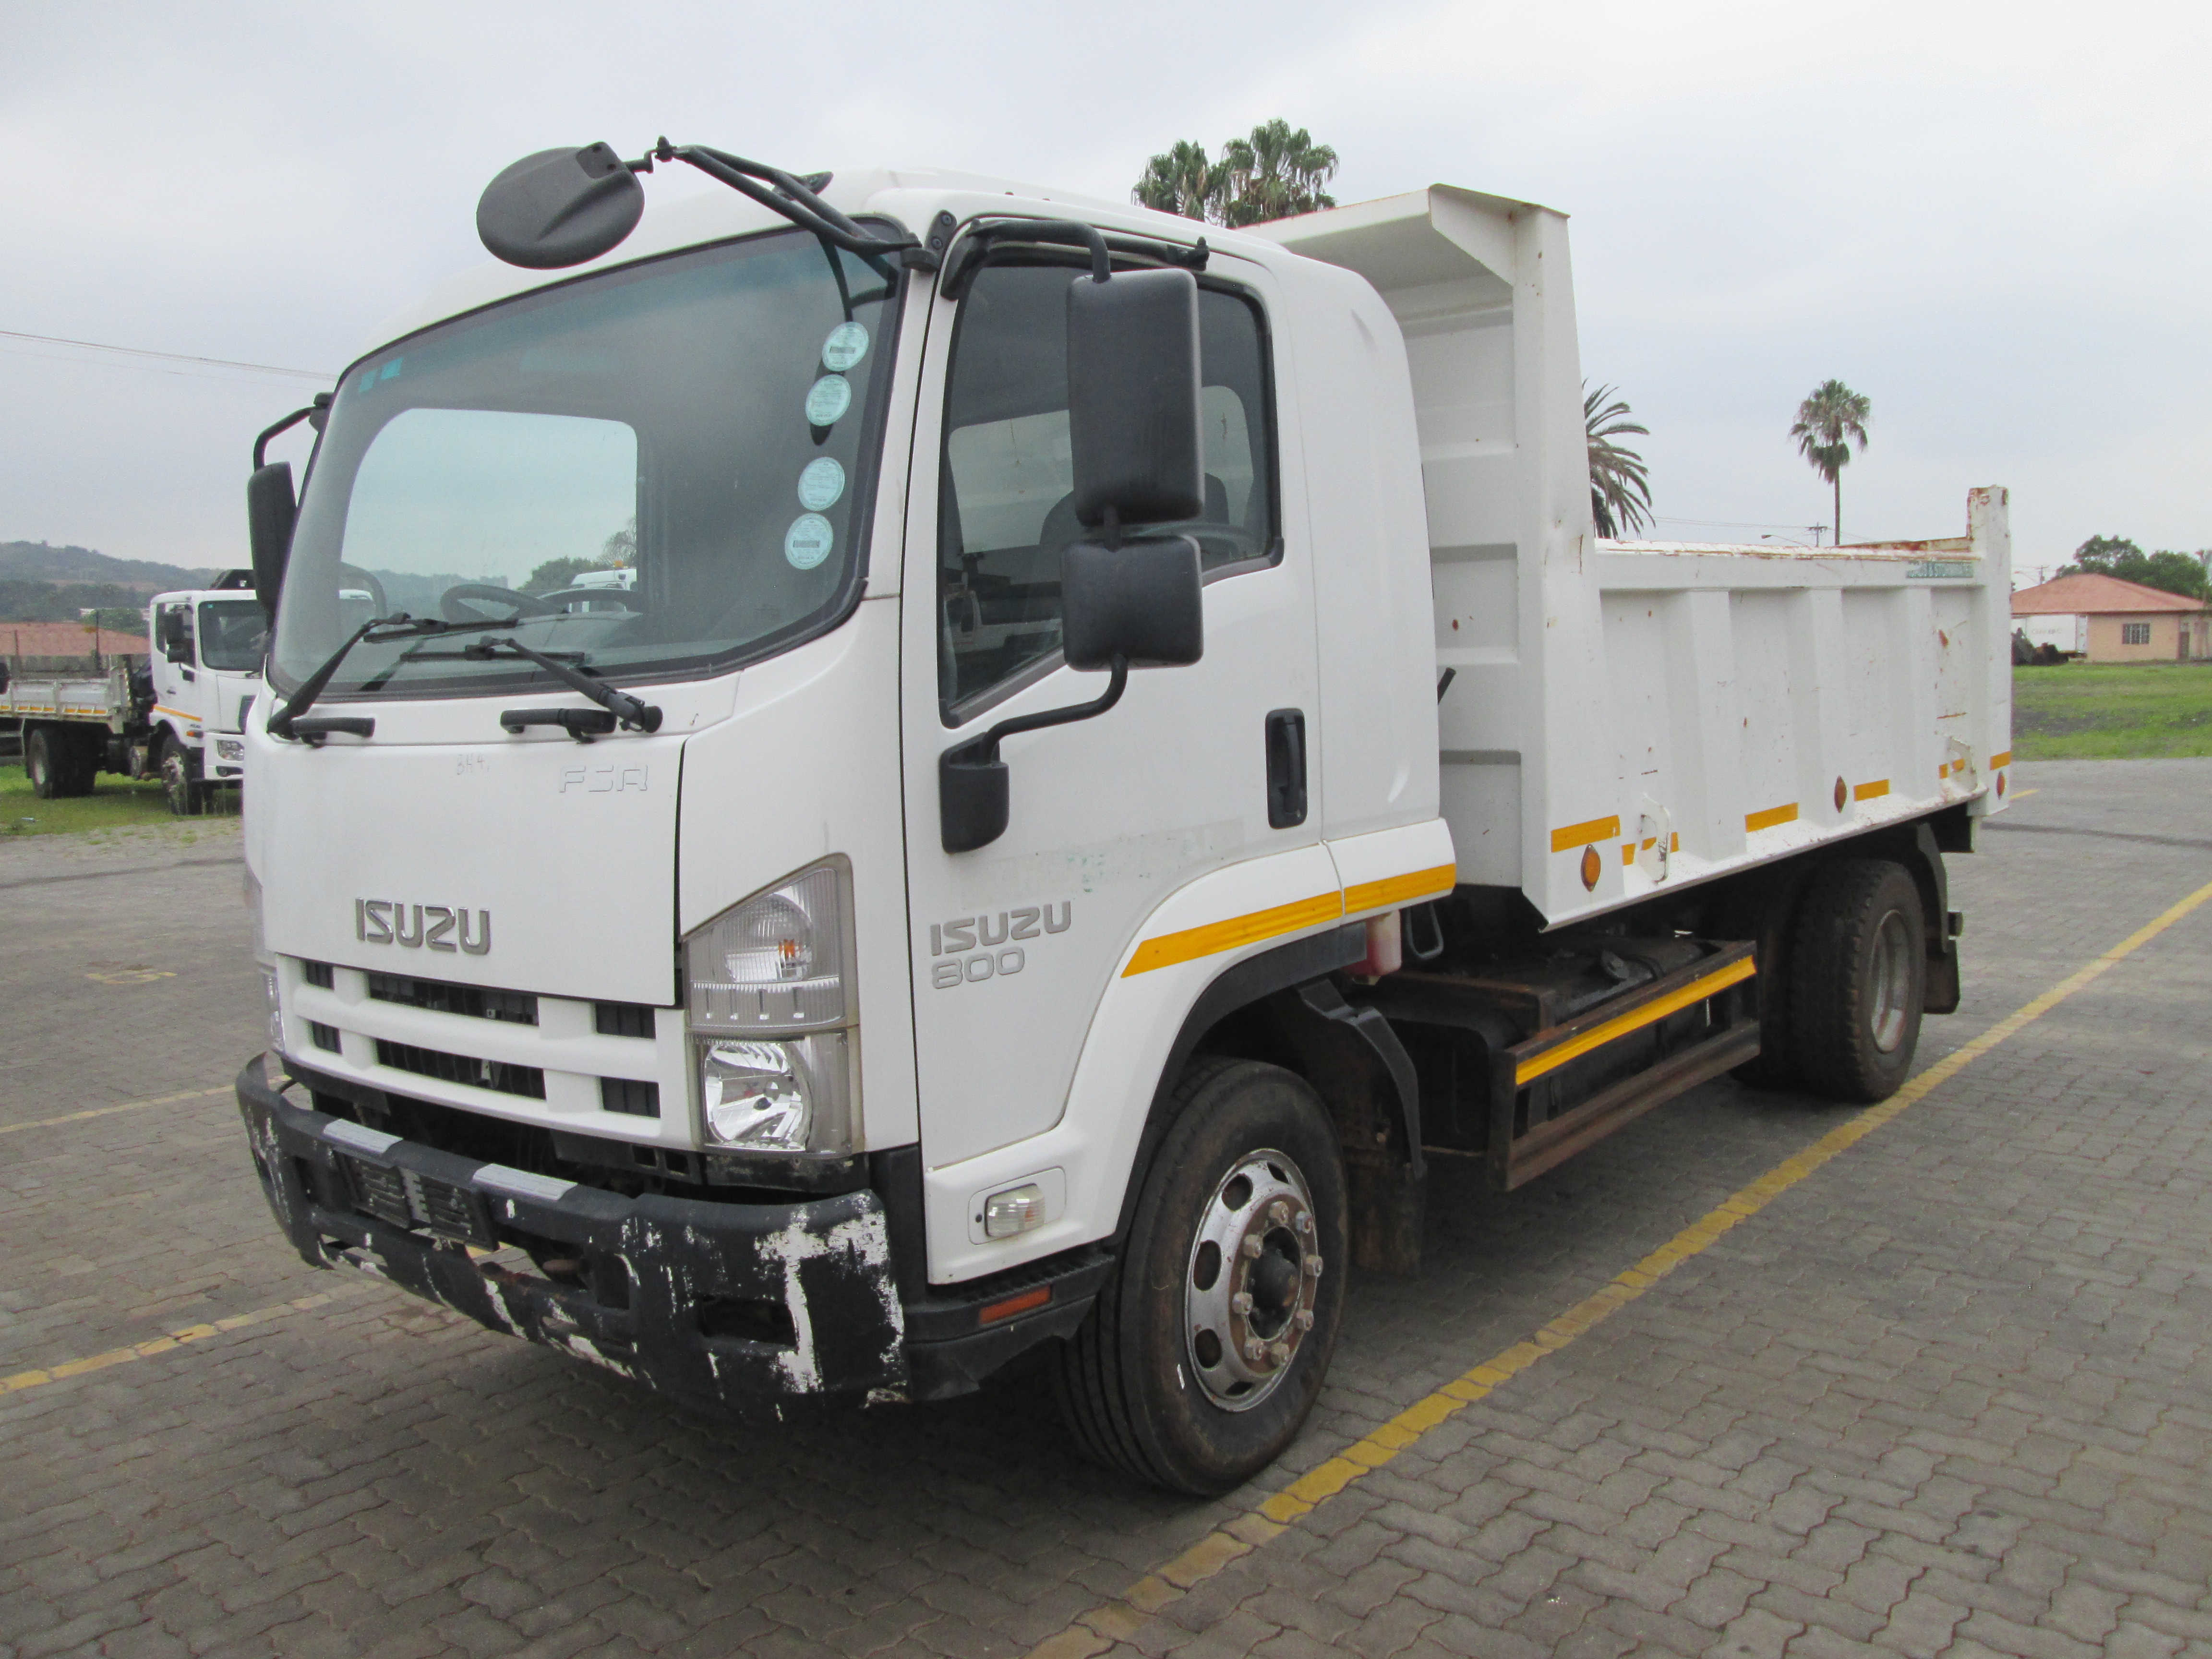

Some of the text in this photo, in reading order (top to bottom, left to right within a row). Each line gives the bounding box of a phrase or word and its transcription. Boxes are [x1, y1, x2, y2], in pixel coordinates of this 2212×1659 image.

[559, 764, 649, 793] FSR
[355, 898, 491, 955] ISUZU
[930, 901, 1071, 956] ISUZU
[932, 947, 1025, 989] 800
